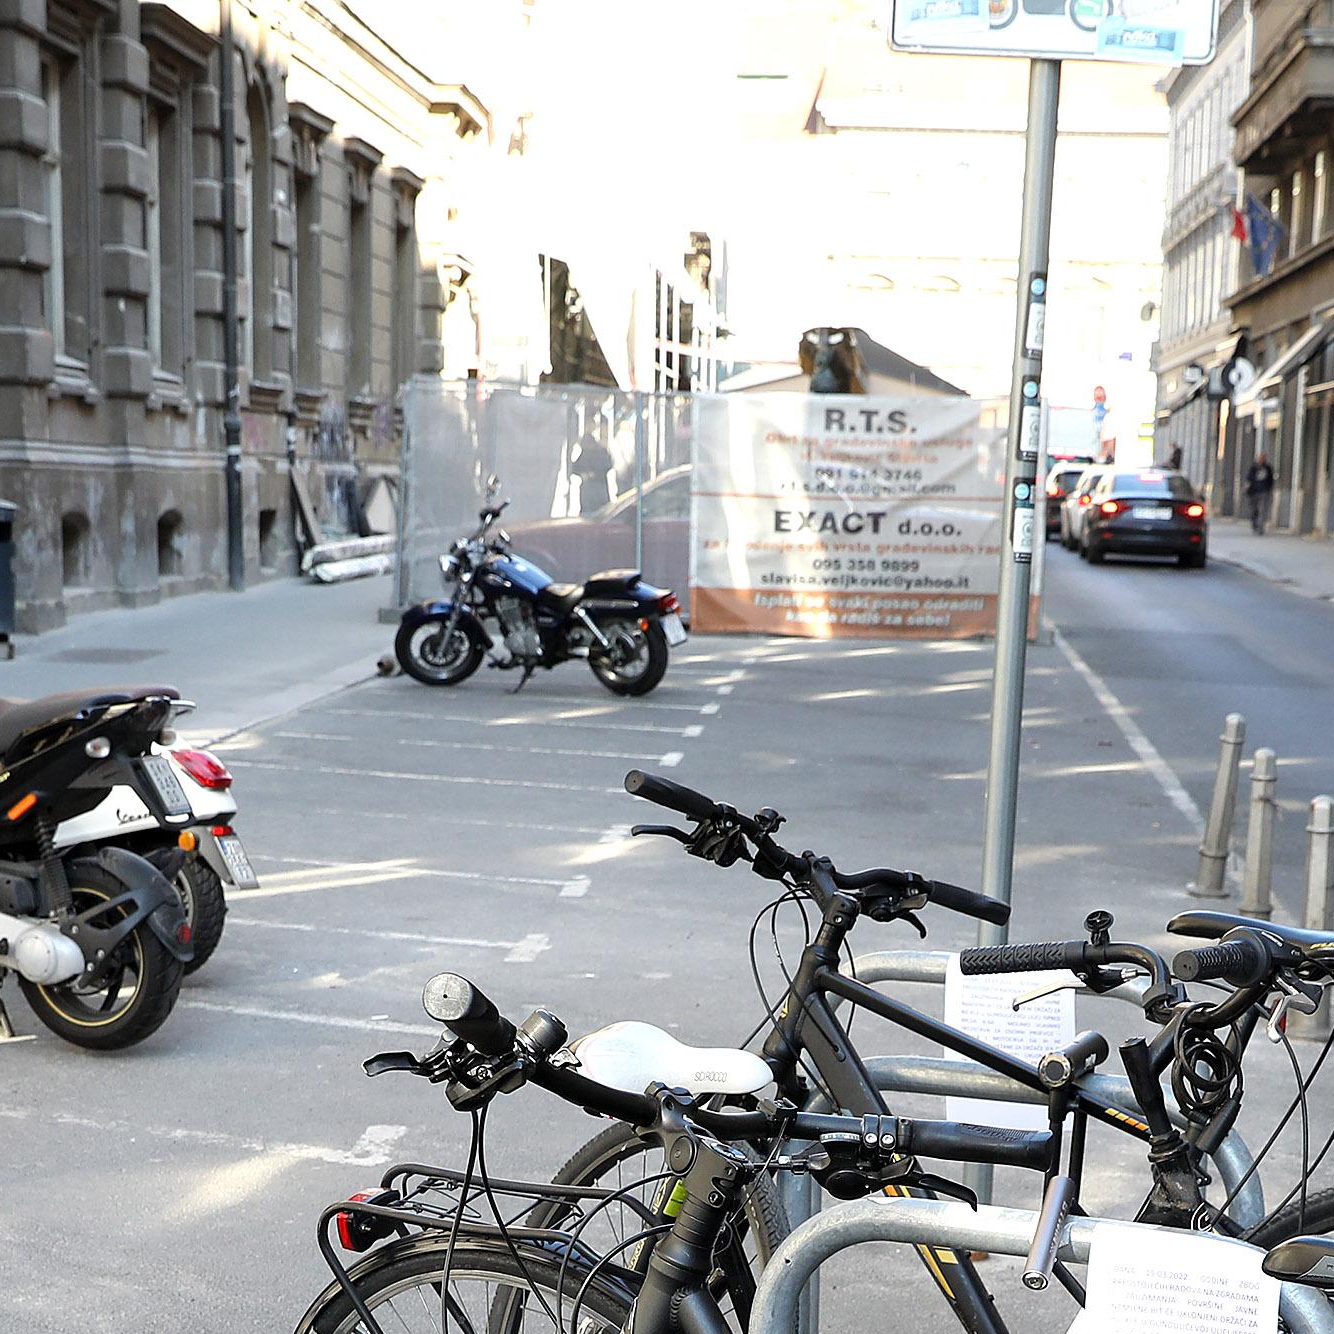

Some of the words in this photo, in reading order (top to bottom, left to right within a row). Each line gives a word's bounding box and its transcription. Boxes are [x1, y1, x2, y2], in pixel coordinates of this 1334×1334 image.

[825, 408, 917, 434] R.T.S.
[774, 510, 886, 535] EXACT
[898, 519, 962, 537] d.o.o.
[1215, 1289, 1259, 1303] ZGRADAMA
[1234, 1305, 1259, 1316] JAVNE
